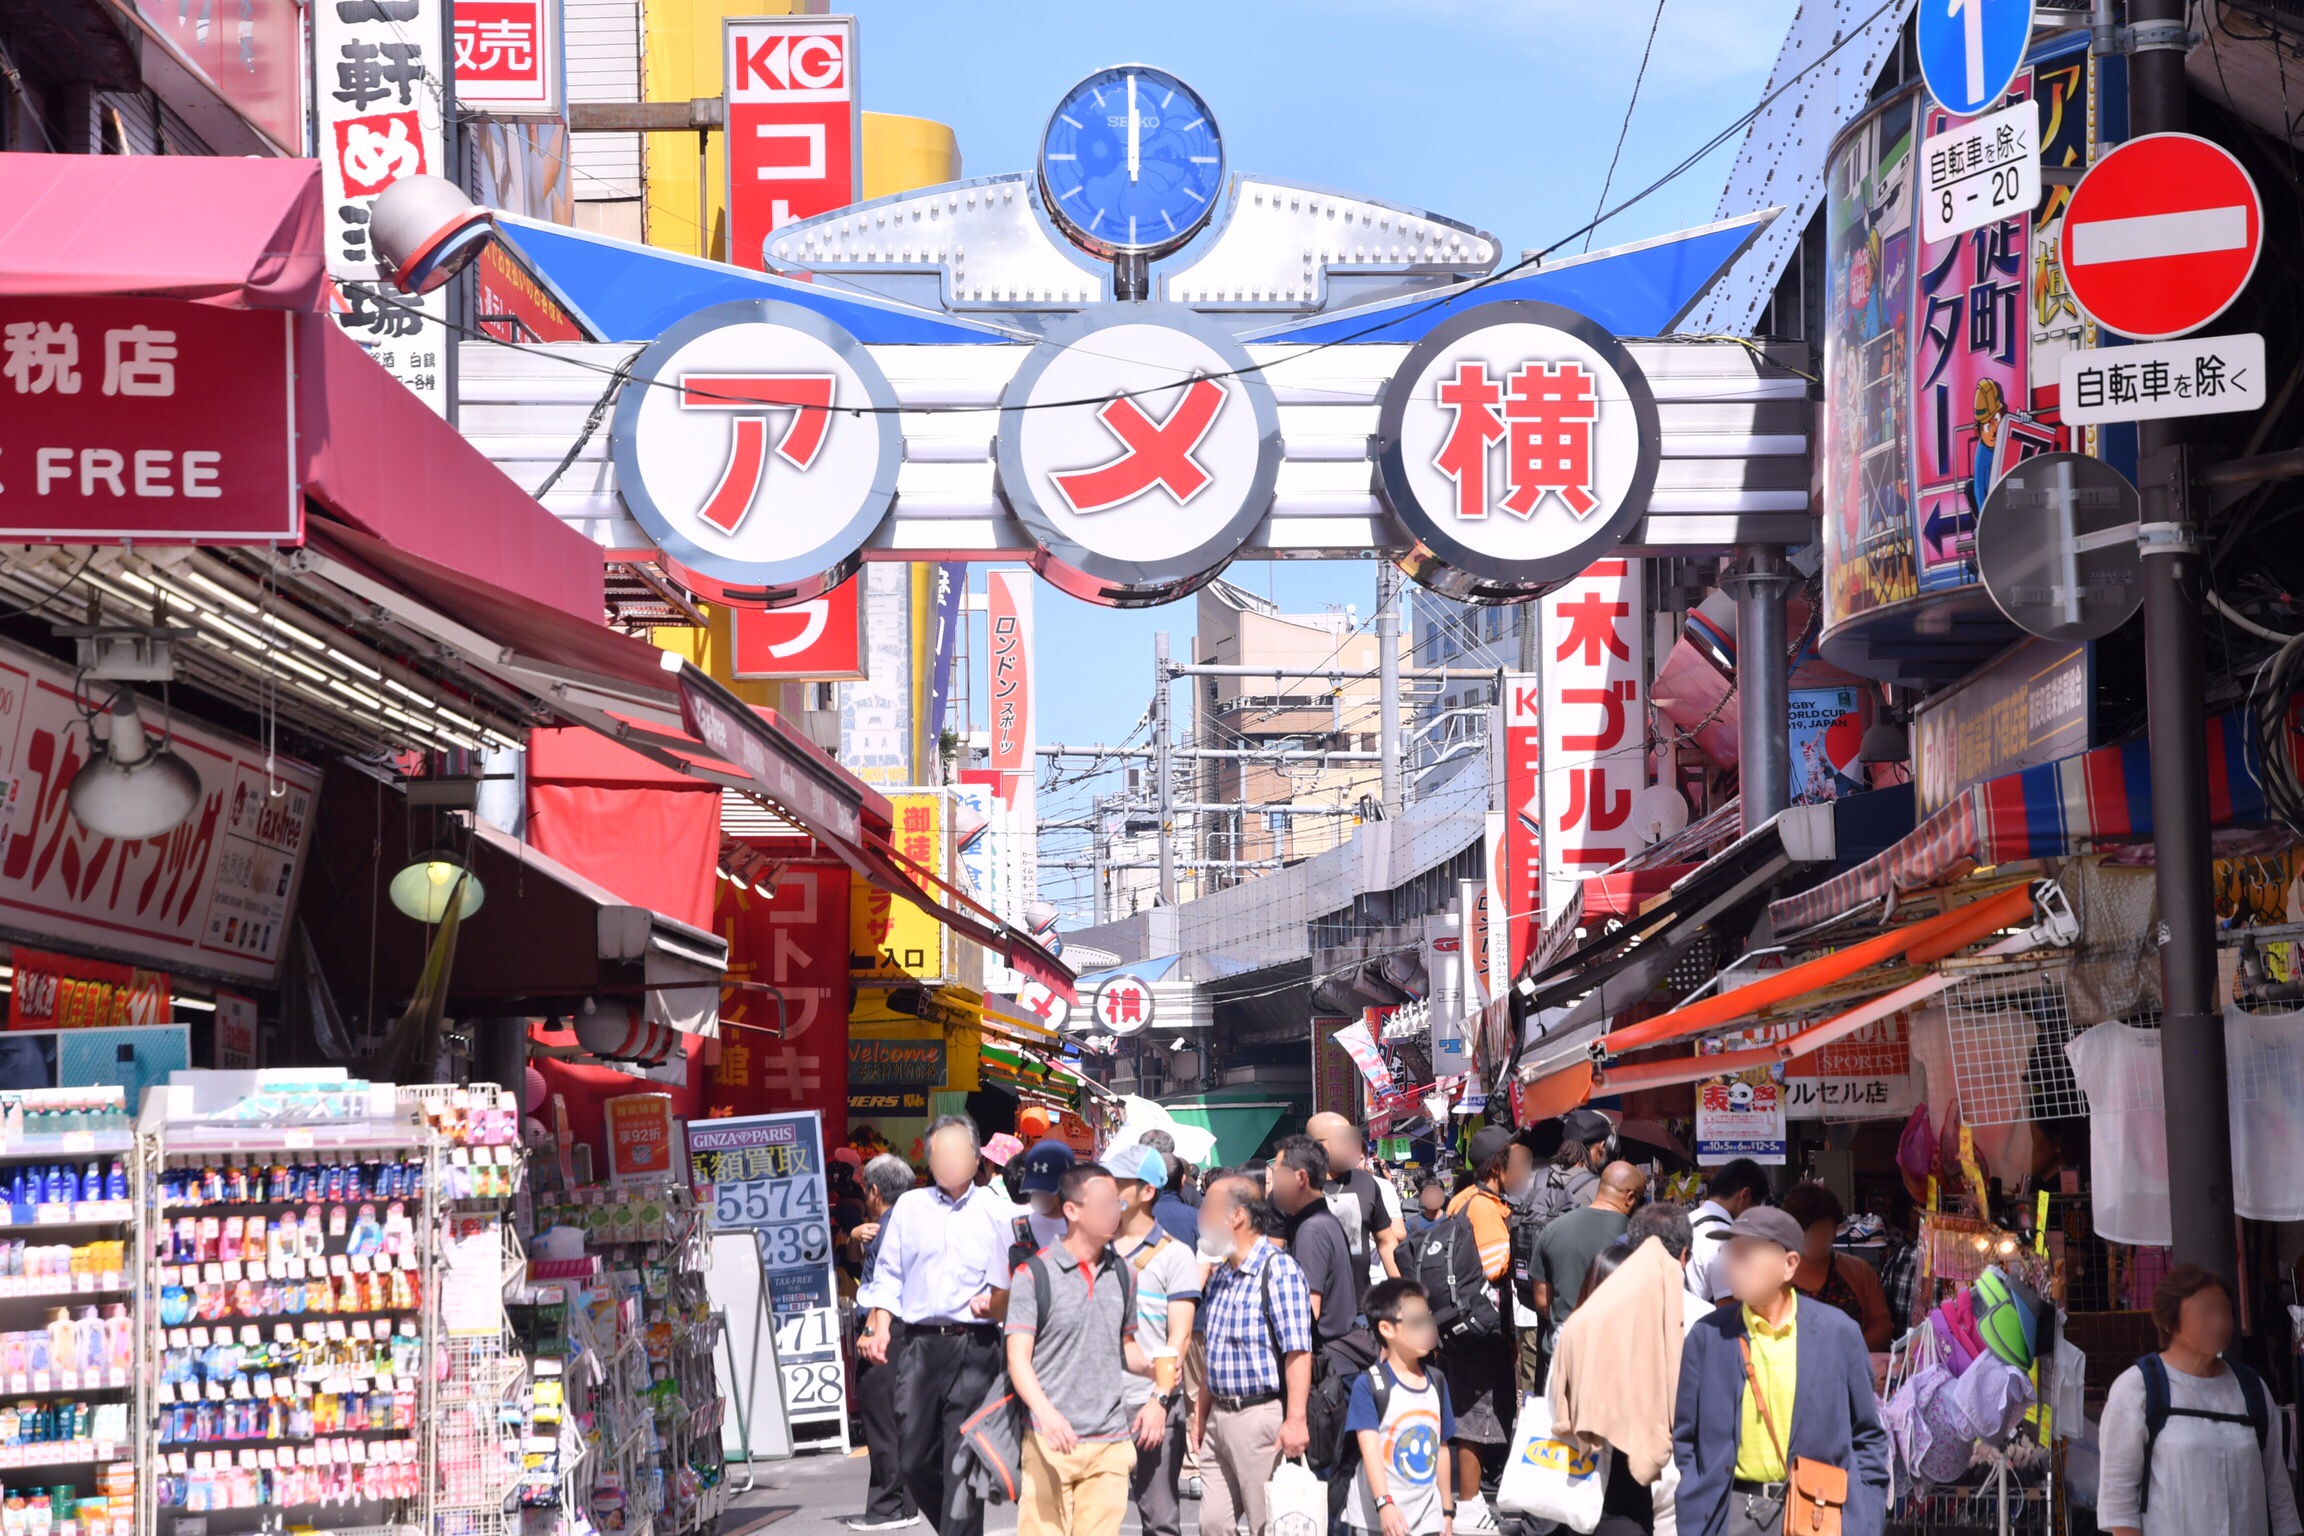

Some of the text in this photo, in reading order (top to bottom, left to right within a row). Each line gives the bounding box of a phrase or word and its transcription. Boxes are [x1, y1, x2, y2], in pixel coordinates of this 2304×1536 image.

[735, 36, 842, 90] KG
[1107, 116, 1160, 128] SEKO
[1931, 124, 2027, 185] 自転車を除く
[410, 352, 436, 368] 白鶴
[2077, 354, 2247, 408] 自転車を除く
[36, 447, 222, 498] FREE
[995, 616, 1017, 754] ロンドン スポーツ
[1556, 560, 1636, 874] 木ゴル
[1789, 709, 1846, 719] ORLD CUP
[1809, 719, 1847, 728] JAPAN
[880, 948, 924, 968] 入口
[764, 872, 831, 1118] コトブキ
[1327, 1049, 1343, 1112] 中田商店
[1822, 1054, 1895, 1069] SPORTS
[693, 1127, 792, 1148] GINZA PARIS
[691, 1143, 811, 1184] 高額買取
[716, 1177, 823, 1222] 5574
